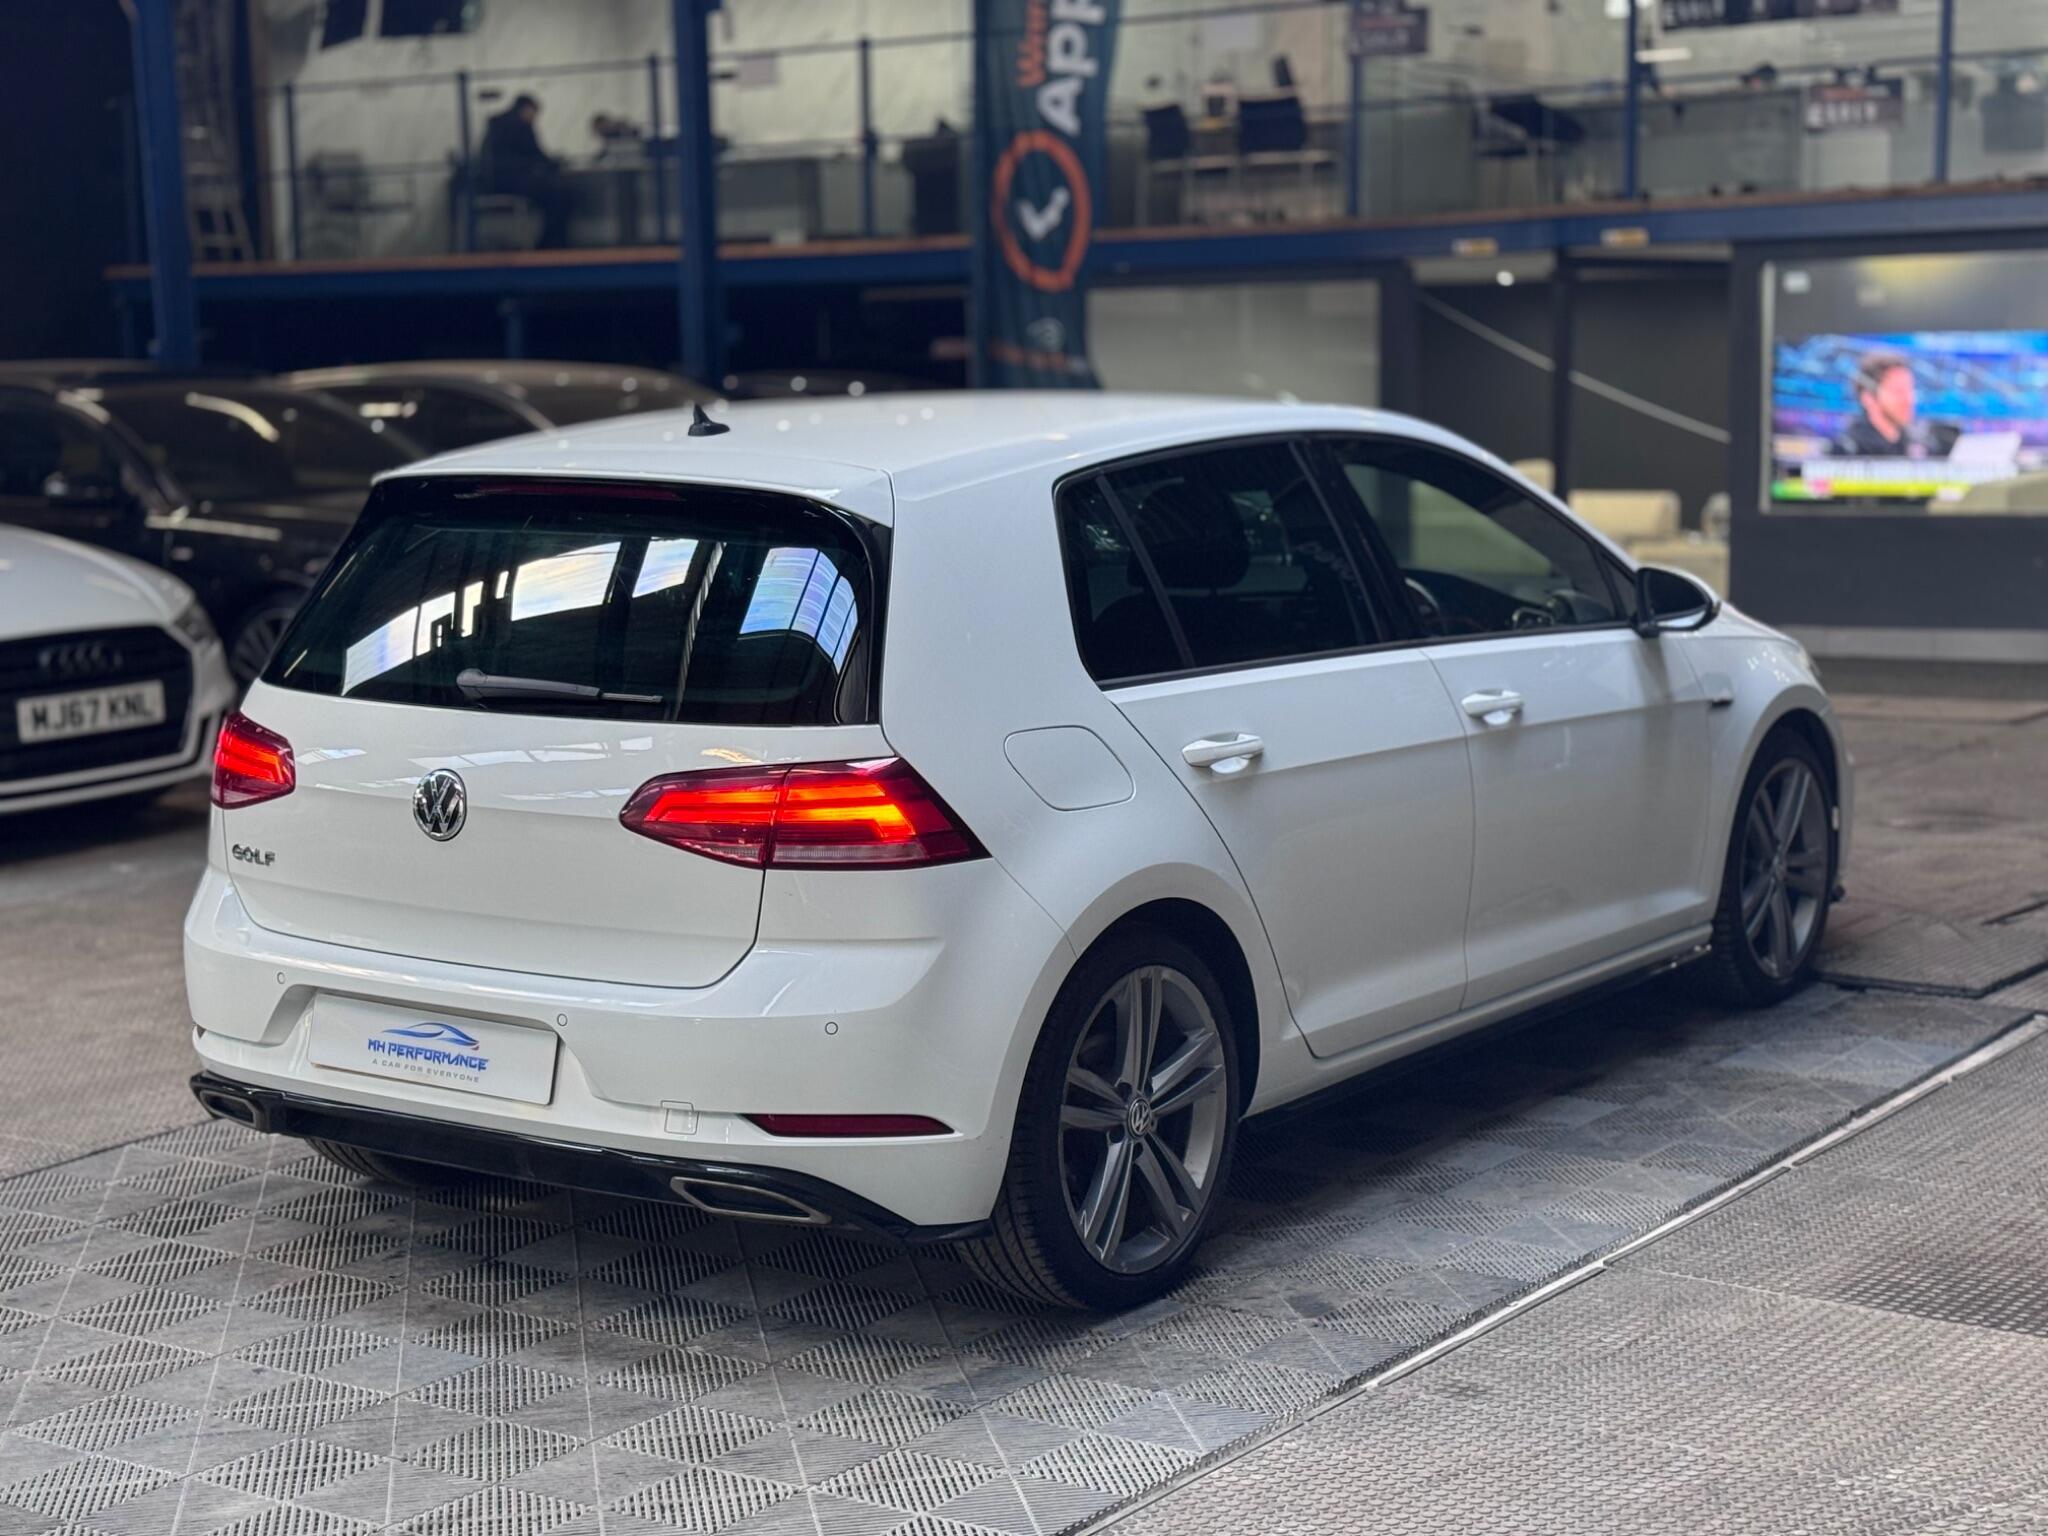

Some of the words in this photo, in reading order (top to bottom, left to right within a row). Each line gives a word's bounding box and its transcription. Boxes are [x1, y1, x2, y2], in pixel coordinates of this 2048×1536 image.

[232, 843, 275, 866] GOLF
[368, 1039, 385, 1053] MH
[387, 1042, 490, 1071] PERFORMANCE
[382, 1060, 401, 1069] CAR
[404, 1064, 423, 1073] FOR
[426, 1068, 480, 1083] EVERYONE
